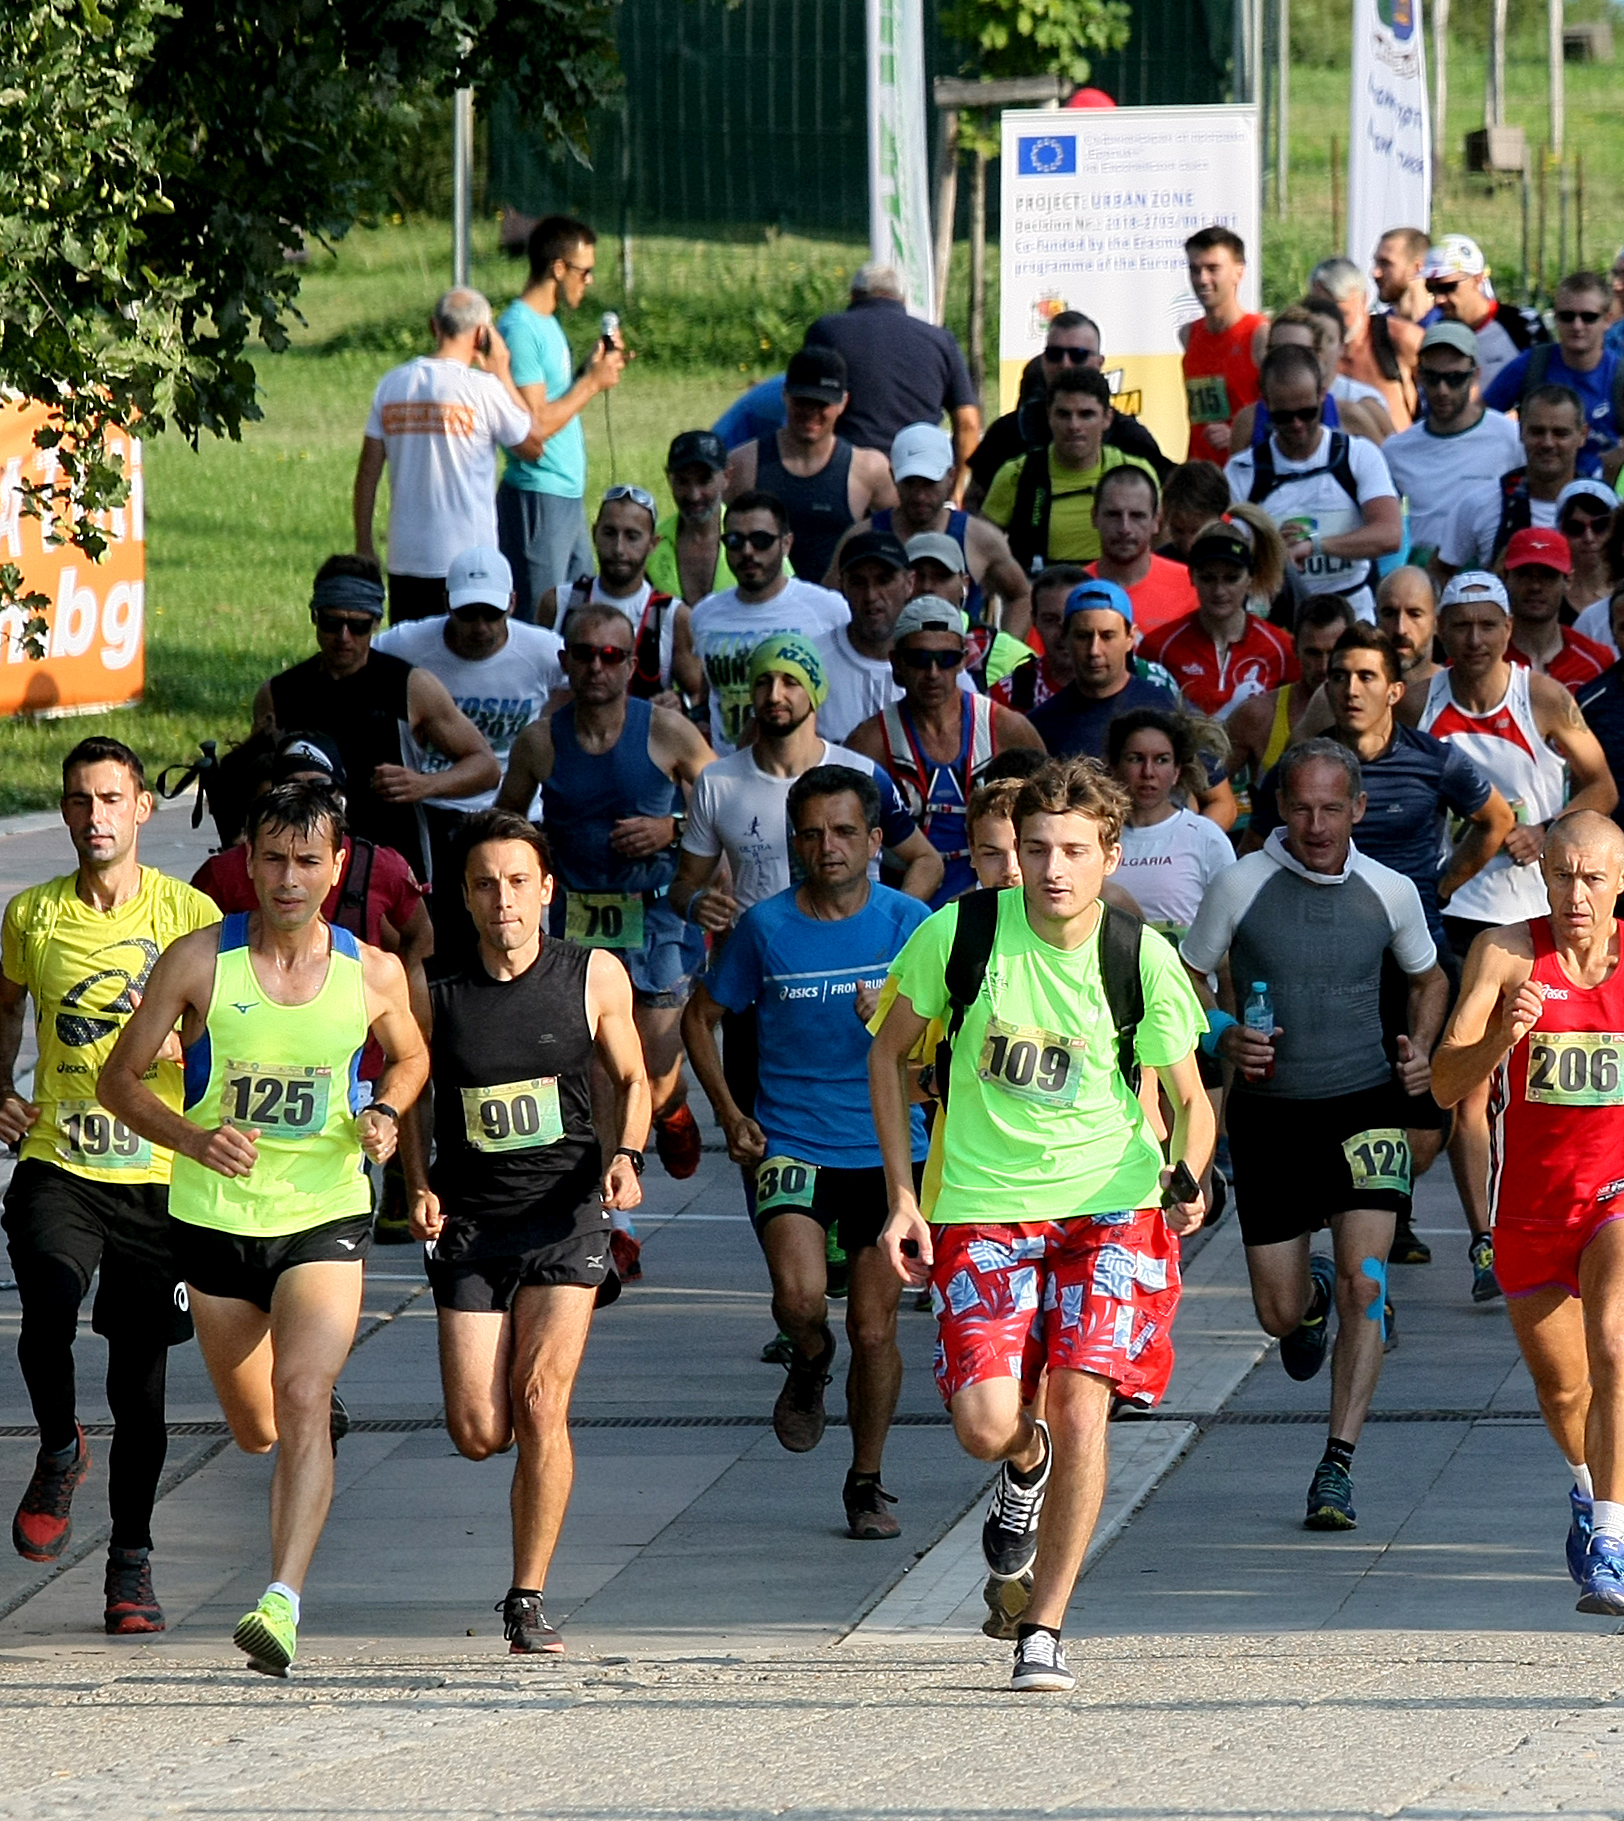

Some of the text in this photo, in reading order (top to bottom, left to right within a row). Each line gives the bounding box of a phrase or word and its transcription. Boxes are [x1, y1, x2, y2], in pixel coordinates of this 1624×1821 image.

[1091, 193, 1146, 209] URBAN
[1151, 190, 1195, 207] ZONE
[1302, 554, 1353, 575] ULA
[1118, 856, 1173, 867] LGARIA
[582, 904, 624, 939] 70
[988, 1034, 1071, 1093] 109
[1528, 1045, 1619, 1093] 206
[229, 1075, 316, 1127] 125
[479, 1094, 541, 1140] 90
[59, 1112, 140, 1157] 199
[1352, 1139, 1409, 1181] 122
